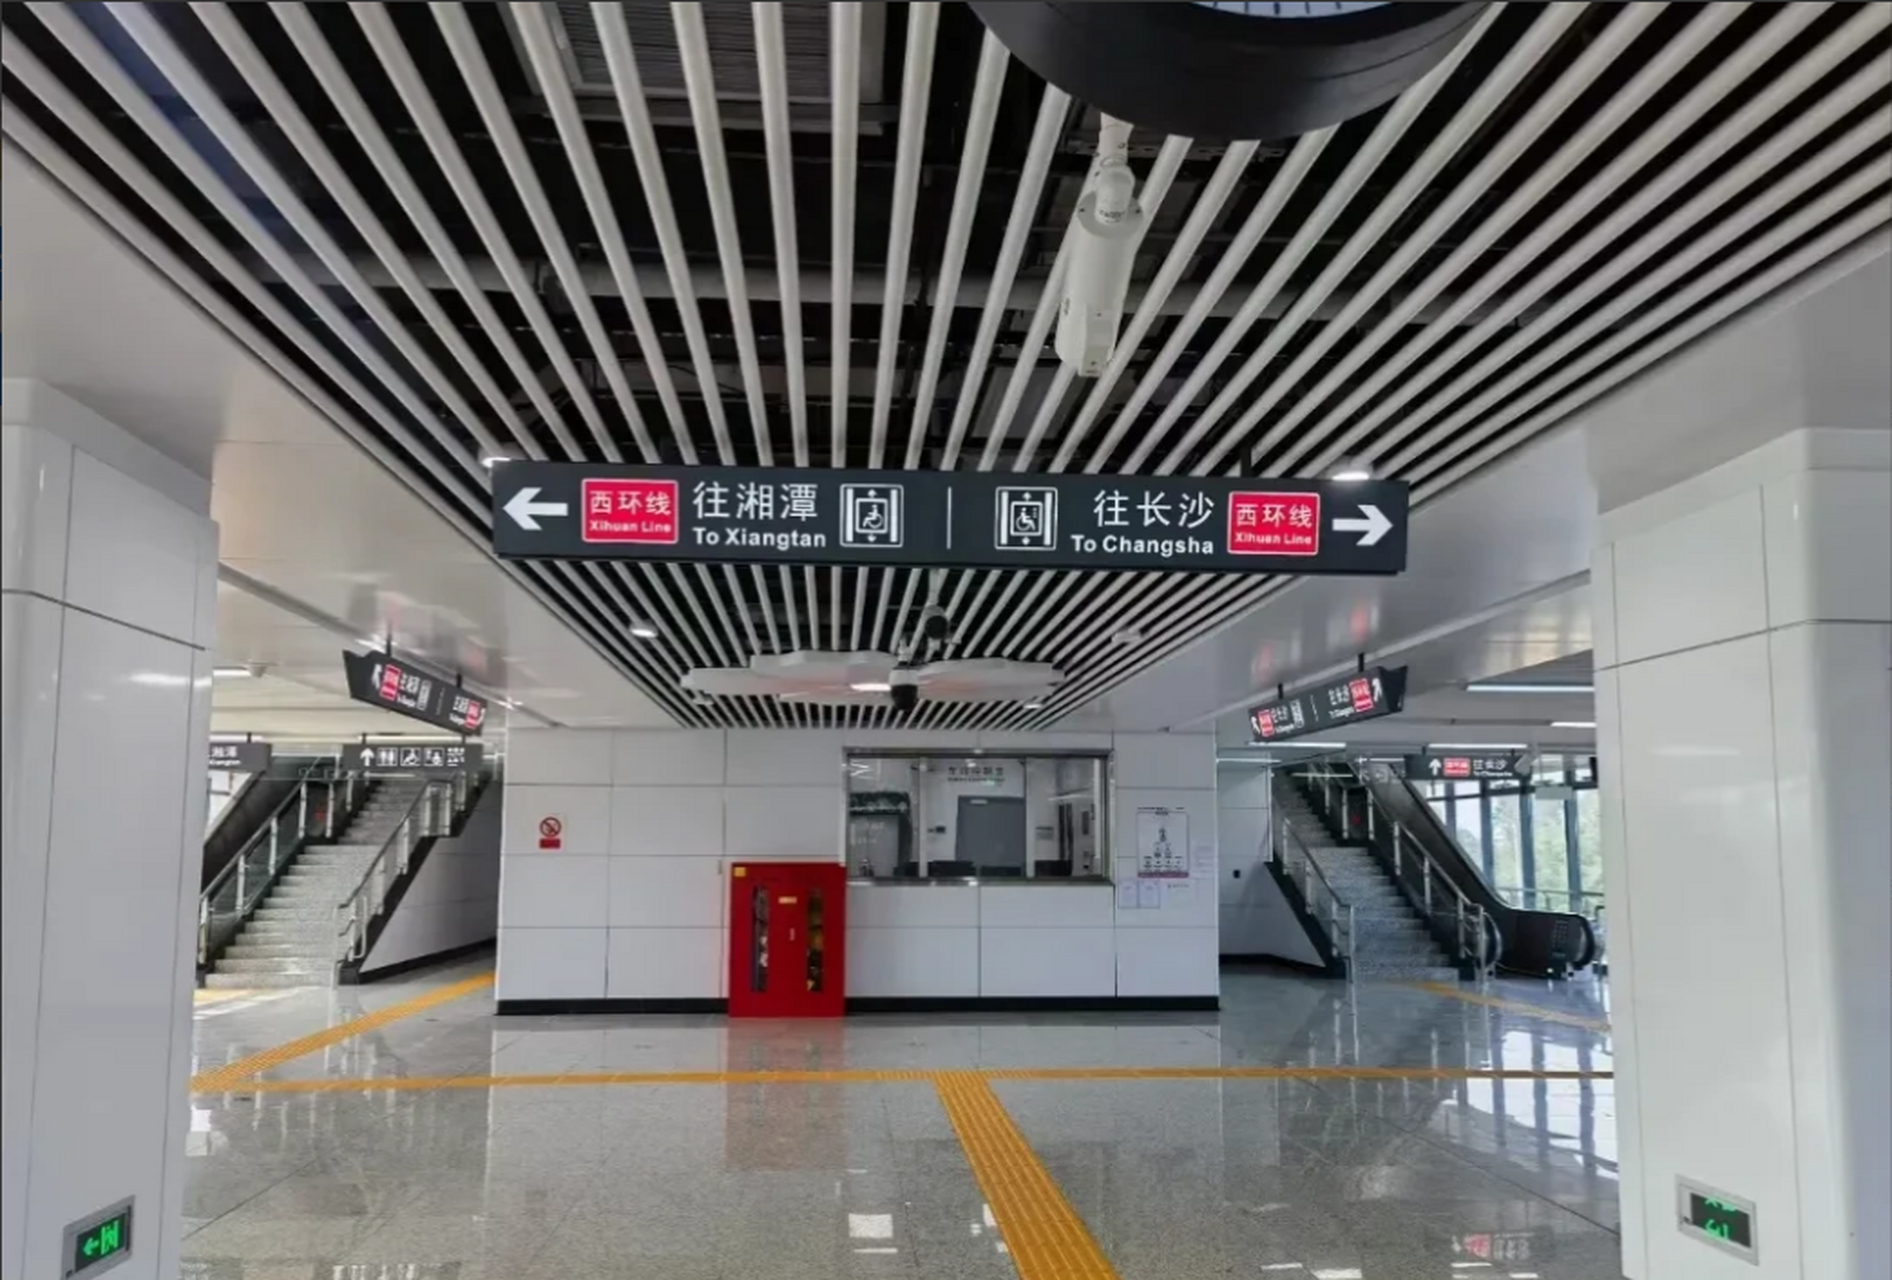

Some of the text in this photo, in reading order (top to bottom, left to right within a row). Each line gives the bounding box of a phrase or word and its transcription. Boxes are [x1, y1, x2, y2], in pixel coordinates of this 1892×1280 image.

[589, 490, 671, 515] 西环线
[692, 481, 818, 521] 往湘潭
[1093, 490, 1214, 528] 往长沙
[589, 520, 672, 533] Xihuan Line
[1235, 503, 1312, 528] 西环线
[692, 527, 826, 551] To Xiangtan
[1070, 534, 1214, 557] To Changsha
[1234, 532, 1312, 545] Xihuan Line
